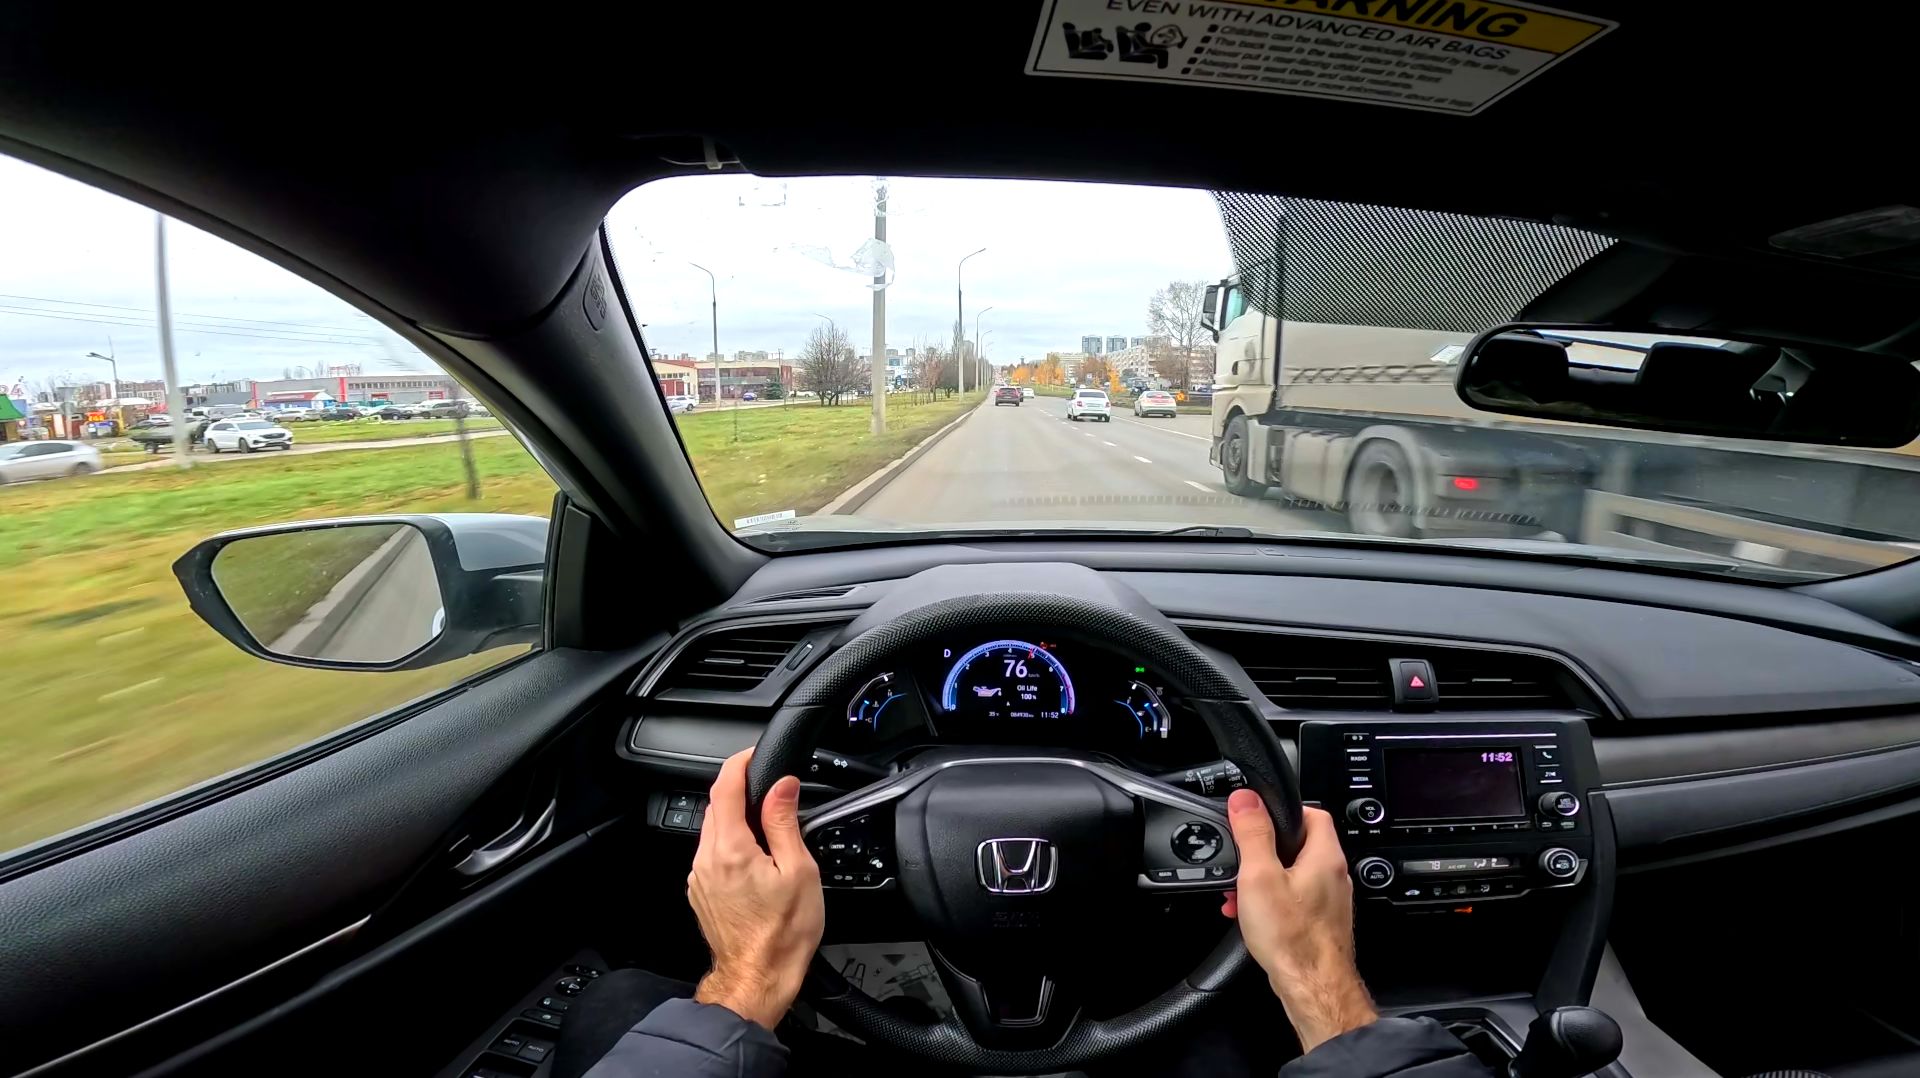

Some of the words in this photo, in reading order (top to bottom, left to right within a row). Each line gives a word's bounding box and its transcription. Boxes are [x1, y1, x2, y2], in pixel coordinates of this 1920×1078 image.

[1257, 0, 1527, 37] RNING
[1106, 0, 1180, 15] EVEN
[1188, 5, 1255, 23] WITH
[1256, 13, 1395, 41] ADVANCED
[1395, 33, 1441, 49] AIR
[1441, 40, 1511, 60] BAGS
[943, 648, 951, 658] D
[1003, 659, 1028, 678] 76
[1016, 684, 1026, 692] Oil
[1026, 684, 1038, 692] Life
[1041, 711, 1059, 719] 11:52
[1481, 752, 1513, 763] 11:52
